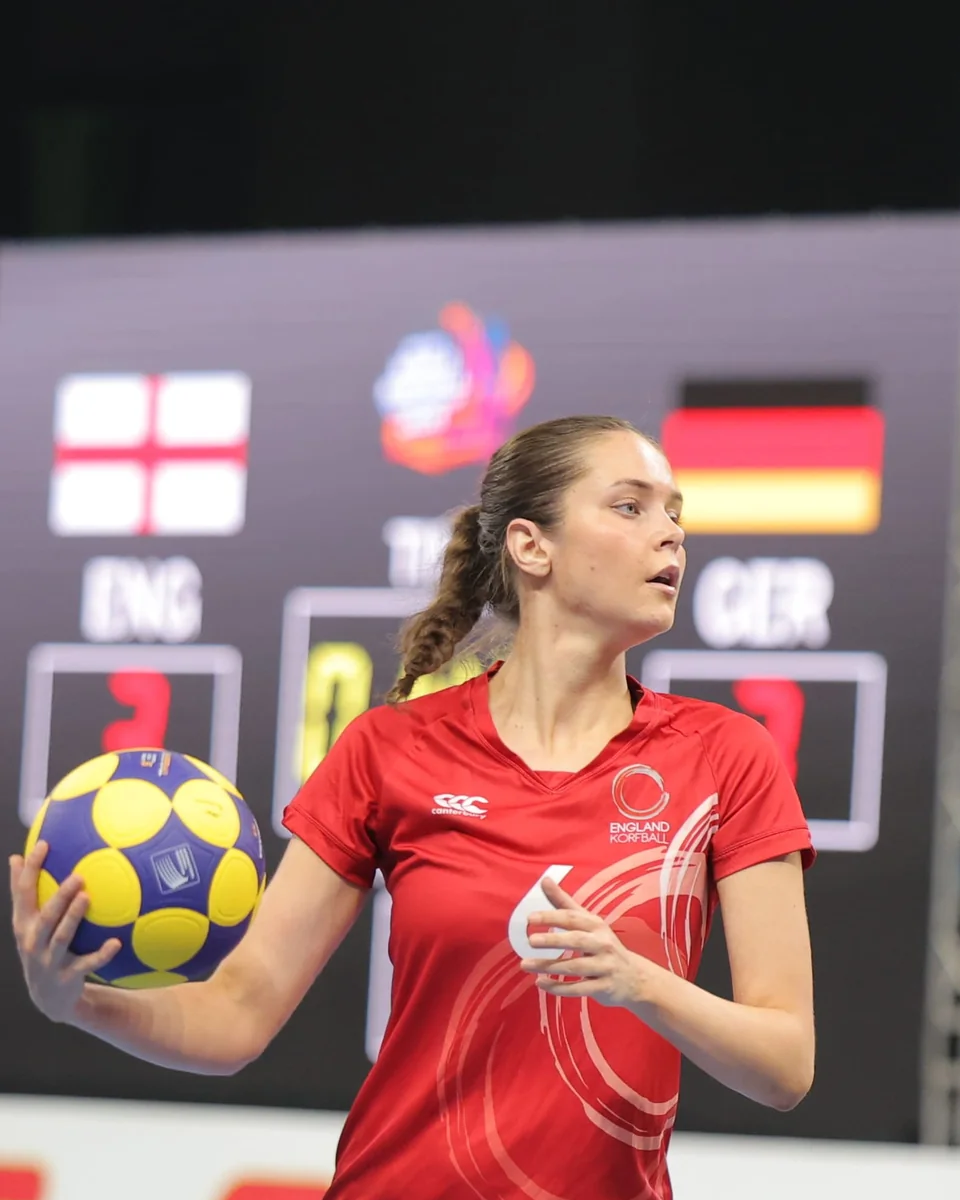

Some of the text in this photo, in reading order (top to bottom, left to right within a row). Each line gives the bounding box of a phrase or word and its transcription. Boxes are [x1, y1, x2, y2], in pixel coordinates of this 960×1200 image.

[82, 557, 203, 642] ENG
[694, 557, 834, 649] GER
[610, 821, 670, 833] ENGLAND
[610, 832, 669, 845] KORFBALL
[508, 865, 574, 961] 6
